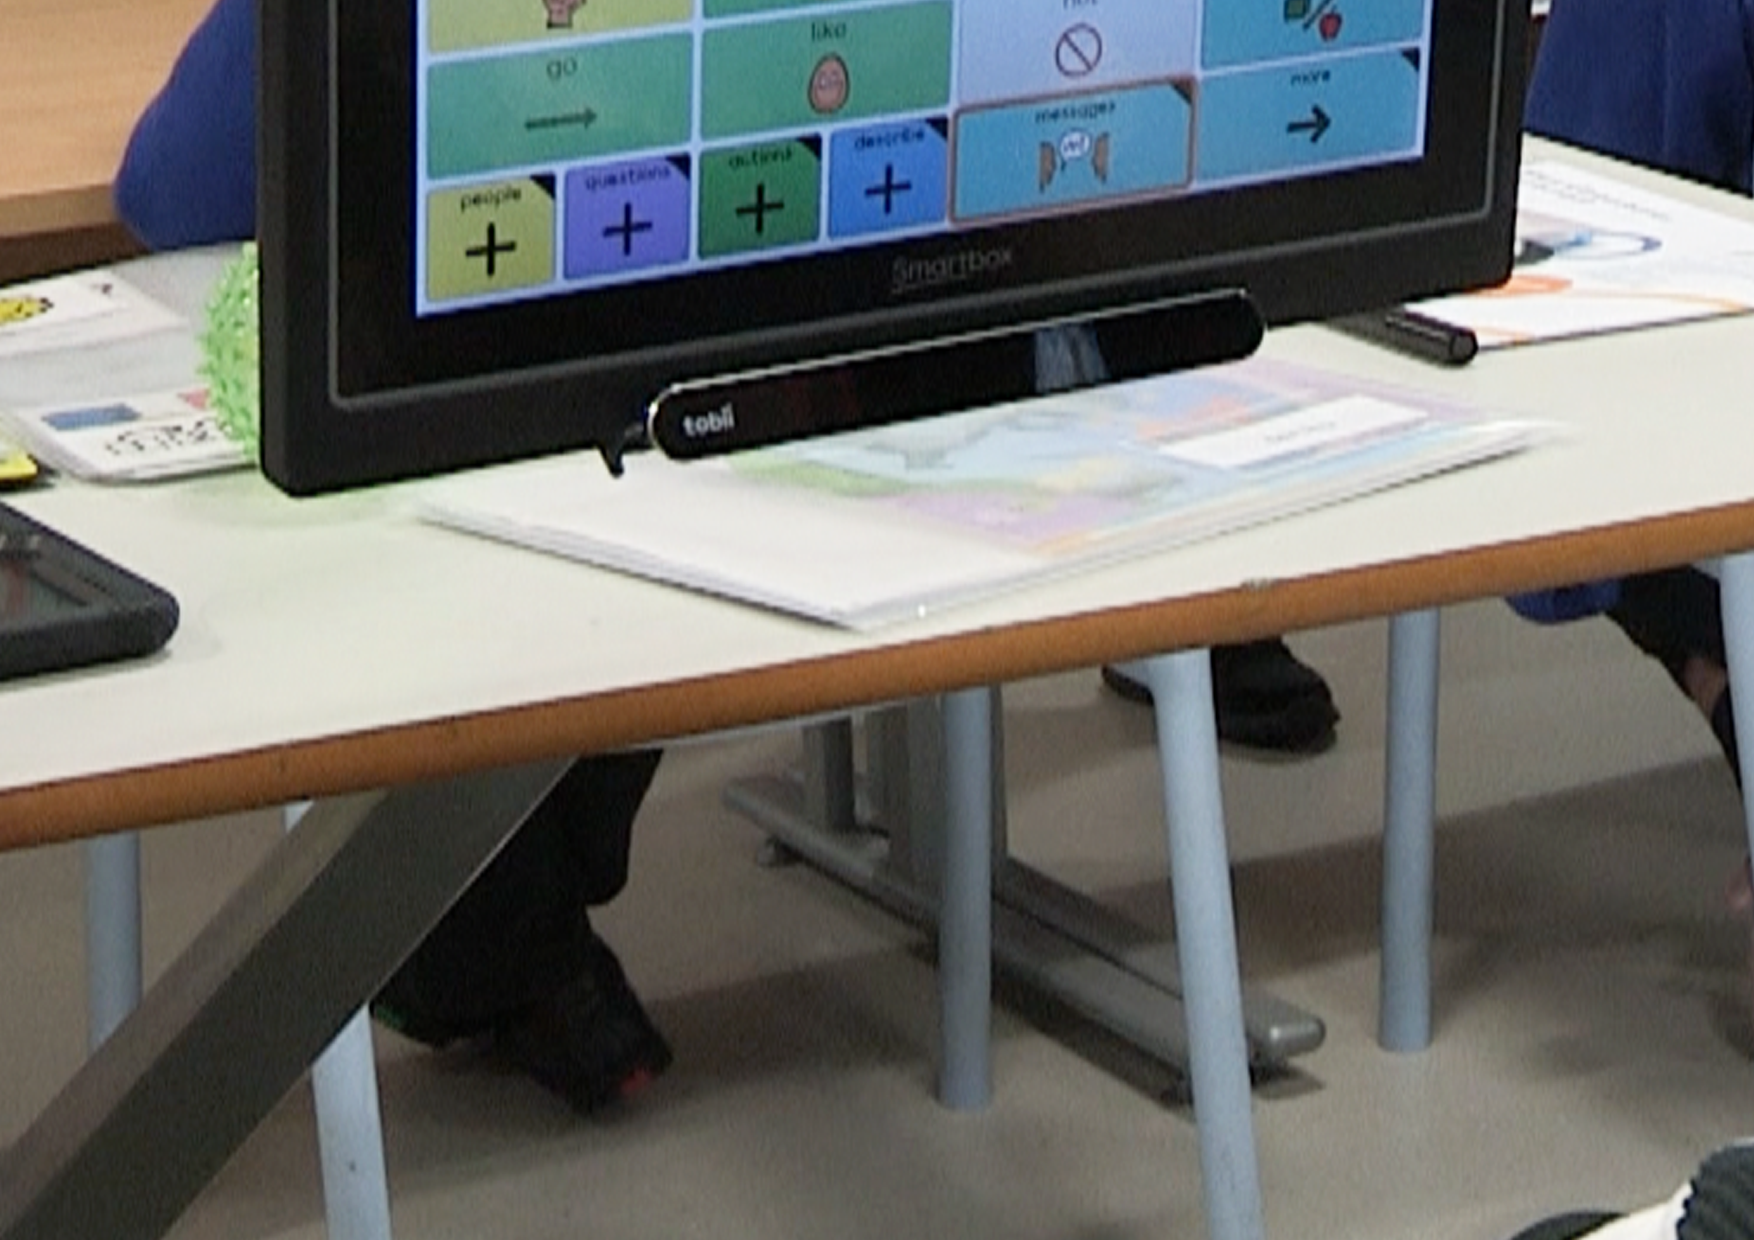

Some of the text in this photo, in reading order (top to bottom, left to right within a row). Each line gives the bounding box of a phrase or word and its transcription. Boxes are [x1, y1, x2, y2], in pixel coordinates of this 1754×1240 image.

[810, 20, 848, 43] like
[545, 57, 579, 81] go
[1290, 67, 1332, 86] more
[1034, 100, 1117, 124] messages
[853, 127, 926, 151] describe
[727, 147, 794, 170] actions
[584, 161, 672, 192] questions
[459, 184, 524, 210] people
[682, 401, 736, 437] tobii
